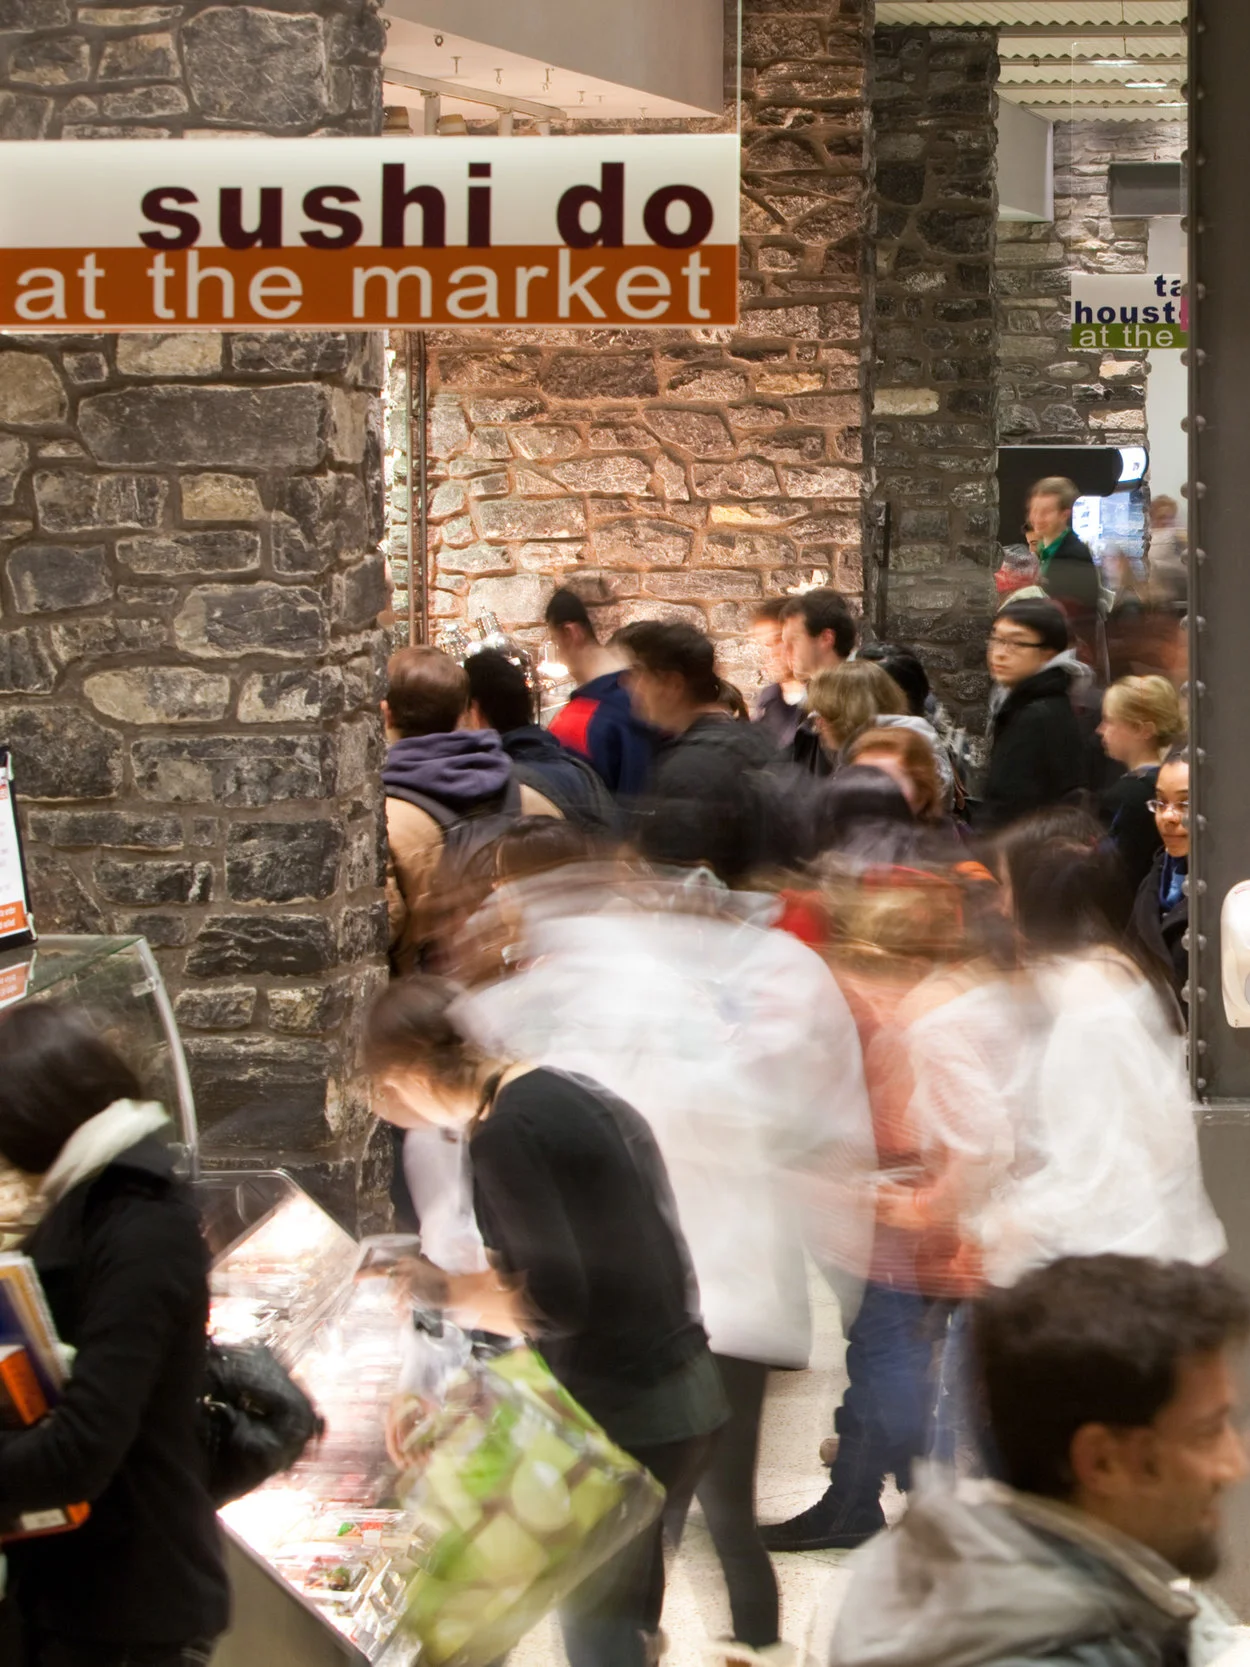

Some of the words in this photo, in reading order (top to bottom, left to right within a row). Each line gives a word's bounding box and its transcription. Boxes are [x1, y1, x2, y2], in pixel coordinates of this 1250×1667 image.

[138, 161, 492, 250] sushi
[556, 161, 714, 249] do
[15, 253, 105, 320] at
[147, 250, 303, 319] the
[352, 248, 711, 319] market
[1075, 300, 1181, 324] houst
[1079, 325, 1109, 347] at
[1122, 324, 1174, 347] the
